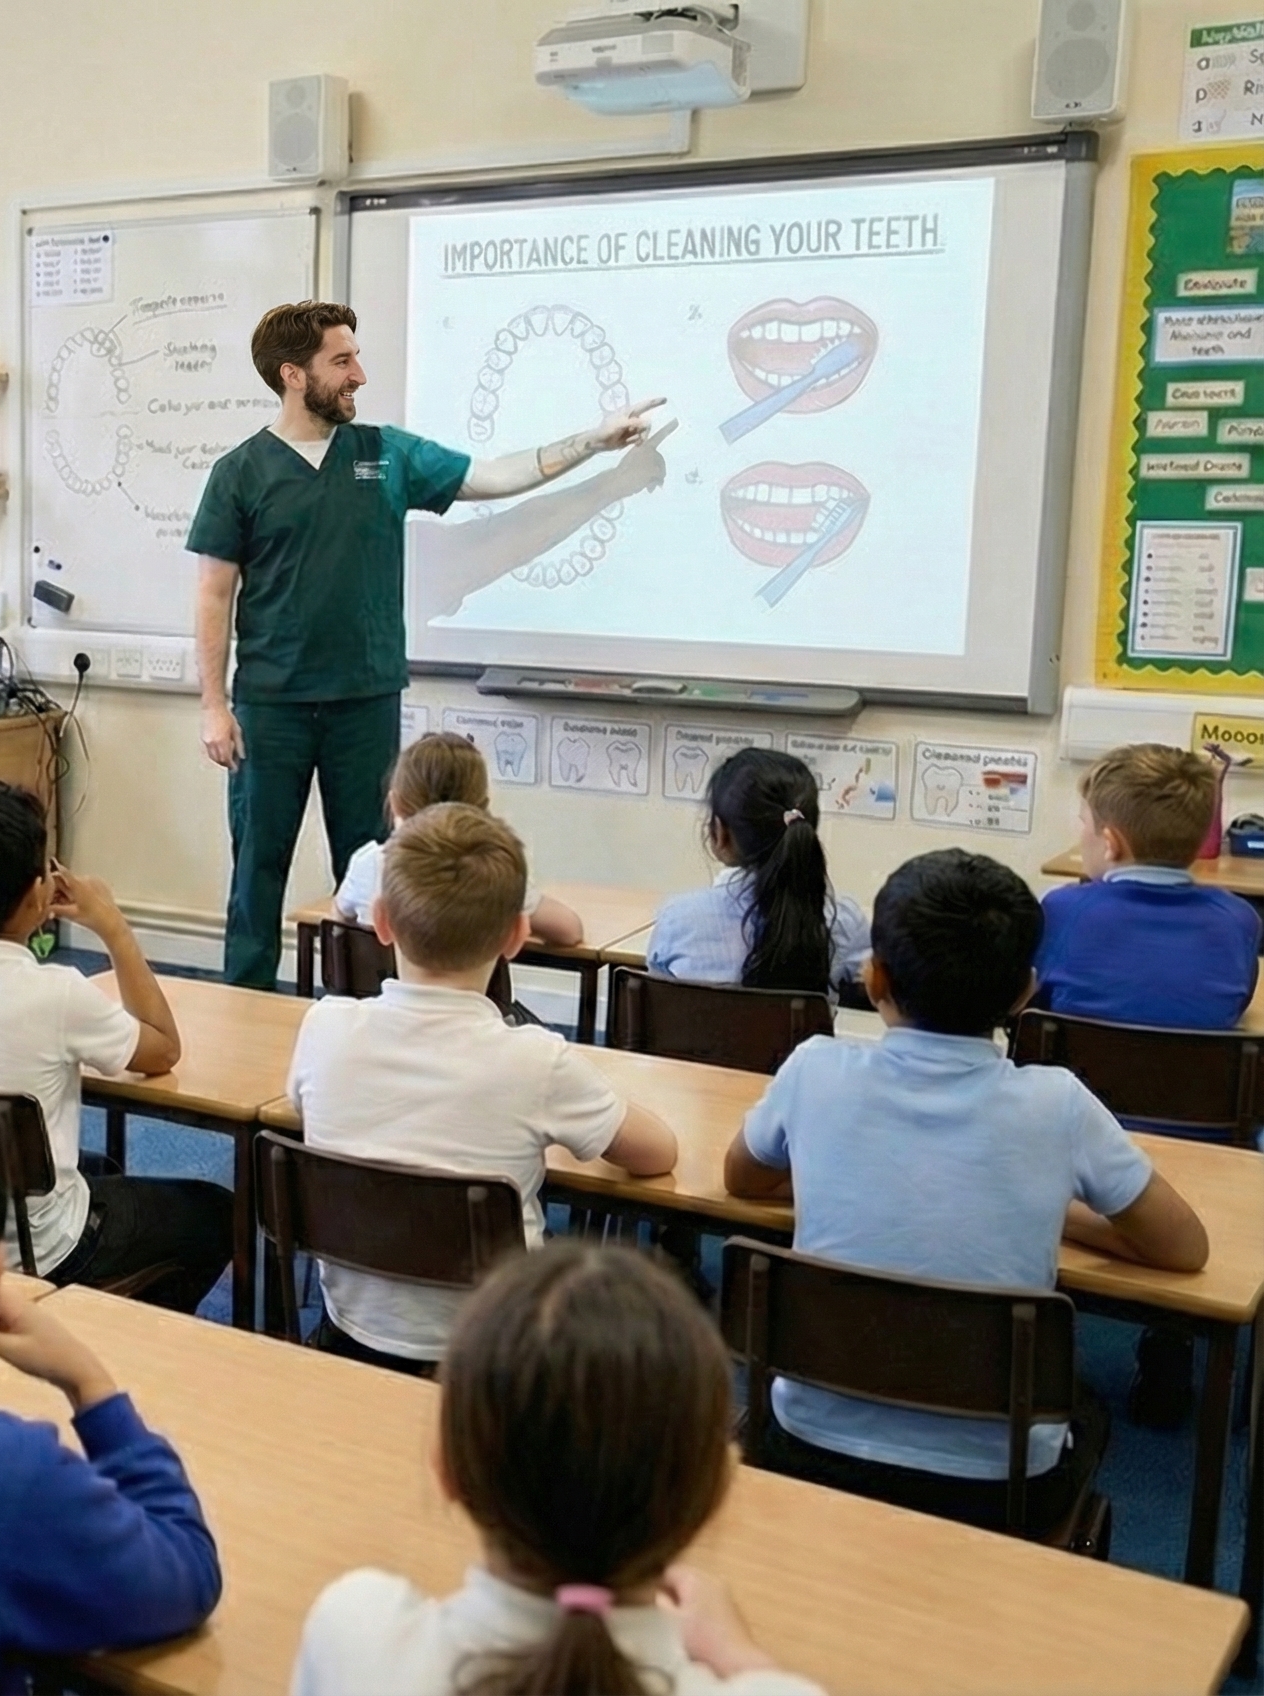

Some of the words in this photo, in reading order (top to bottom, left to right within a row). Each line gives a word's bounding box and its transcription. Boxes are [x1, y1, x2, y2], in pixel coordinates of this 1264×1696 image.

[443, 233, 589, 272] IMPORTANCE
[597, 231, 629, 264] OF
[636, 224, 761, 263] CLEANING
[769, 219, 843, 255] YOUR
[851, 213, 940, 251] TEETH
